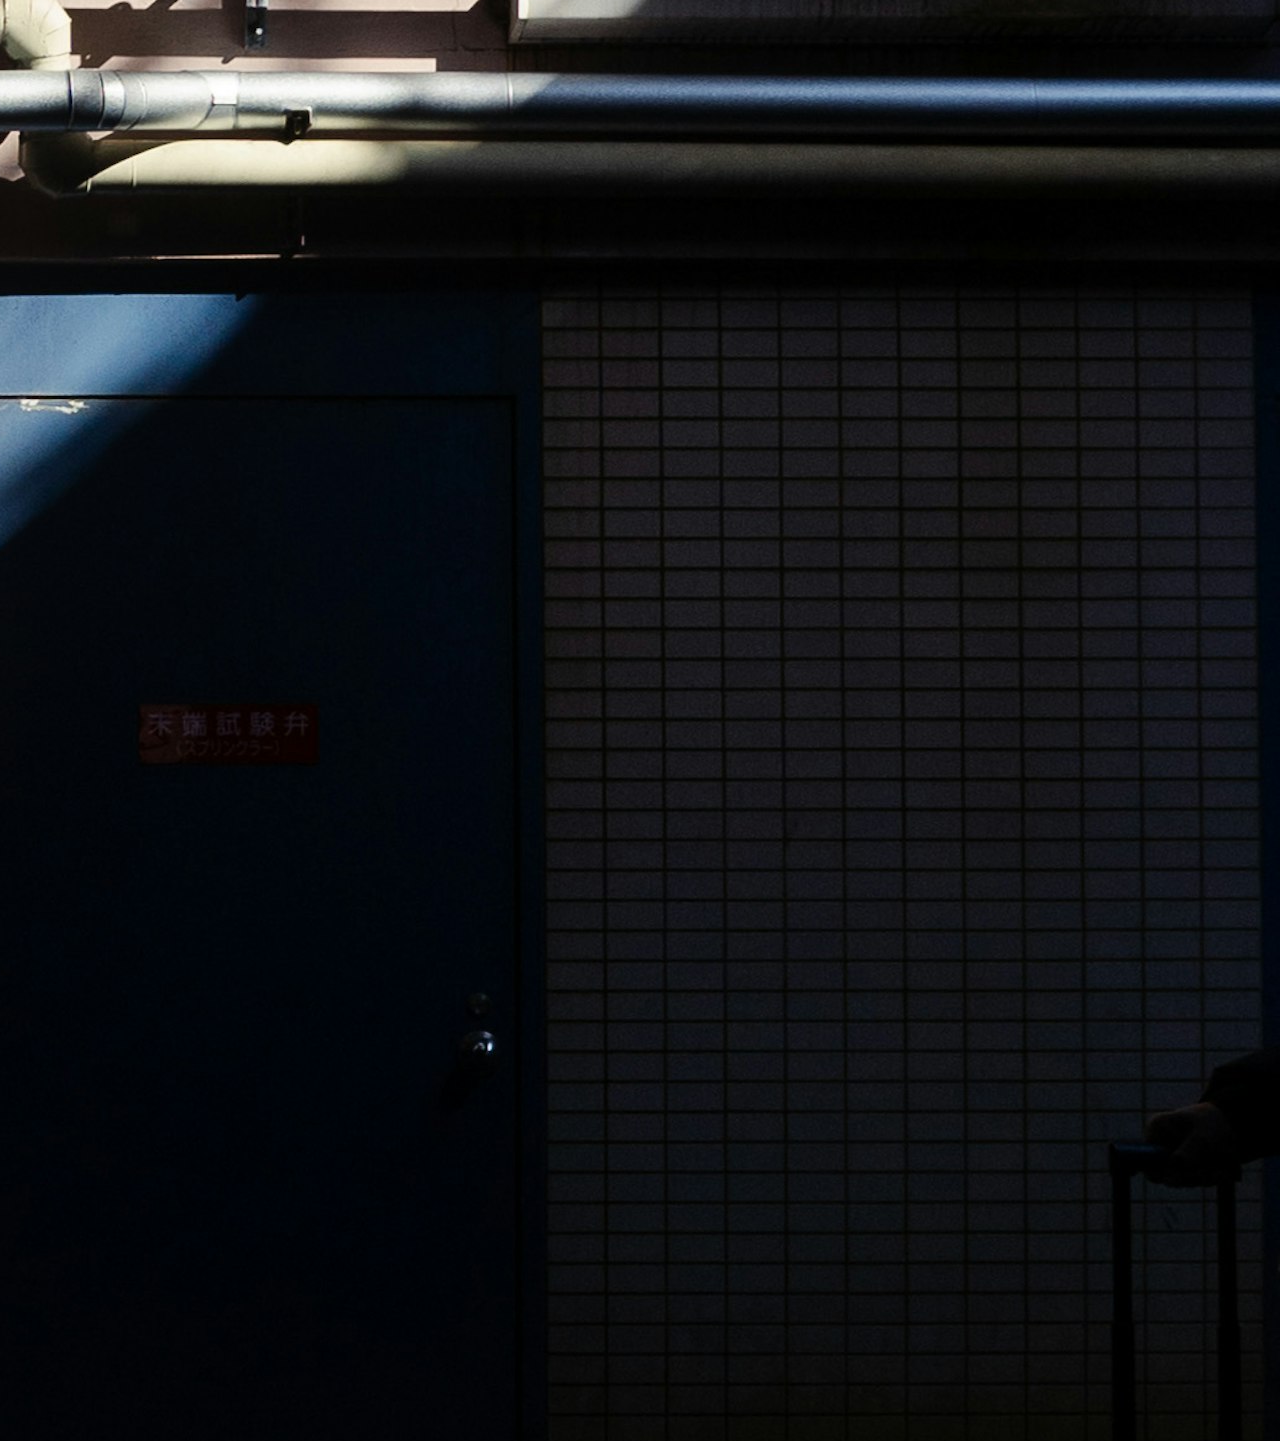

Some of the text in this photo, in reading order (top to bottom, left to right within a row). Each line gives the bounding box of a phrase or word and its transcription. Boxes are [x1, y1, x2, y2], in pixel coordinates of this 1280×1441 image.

[146, 711, 311, 738] 末端試験弁
